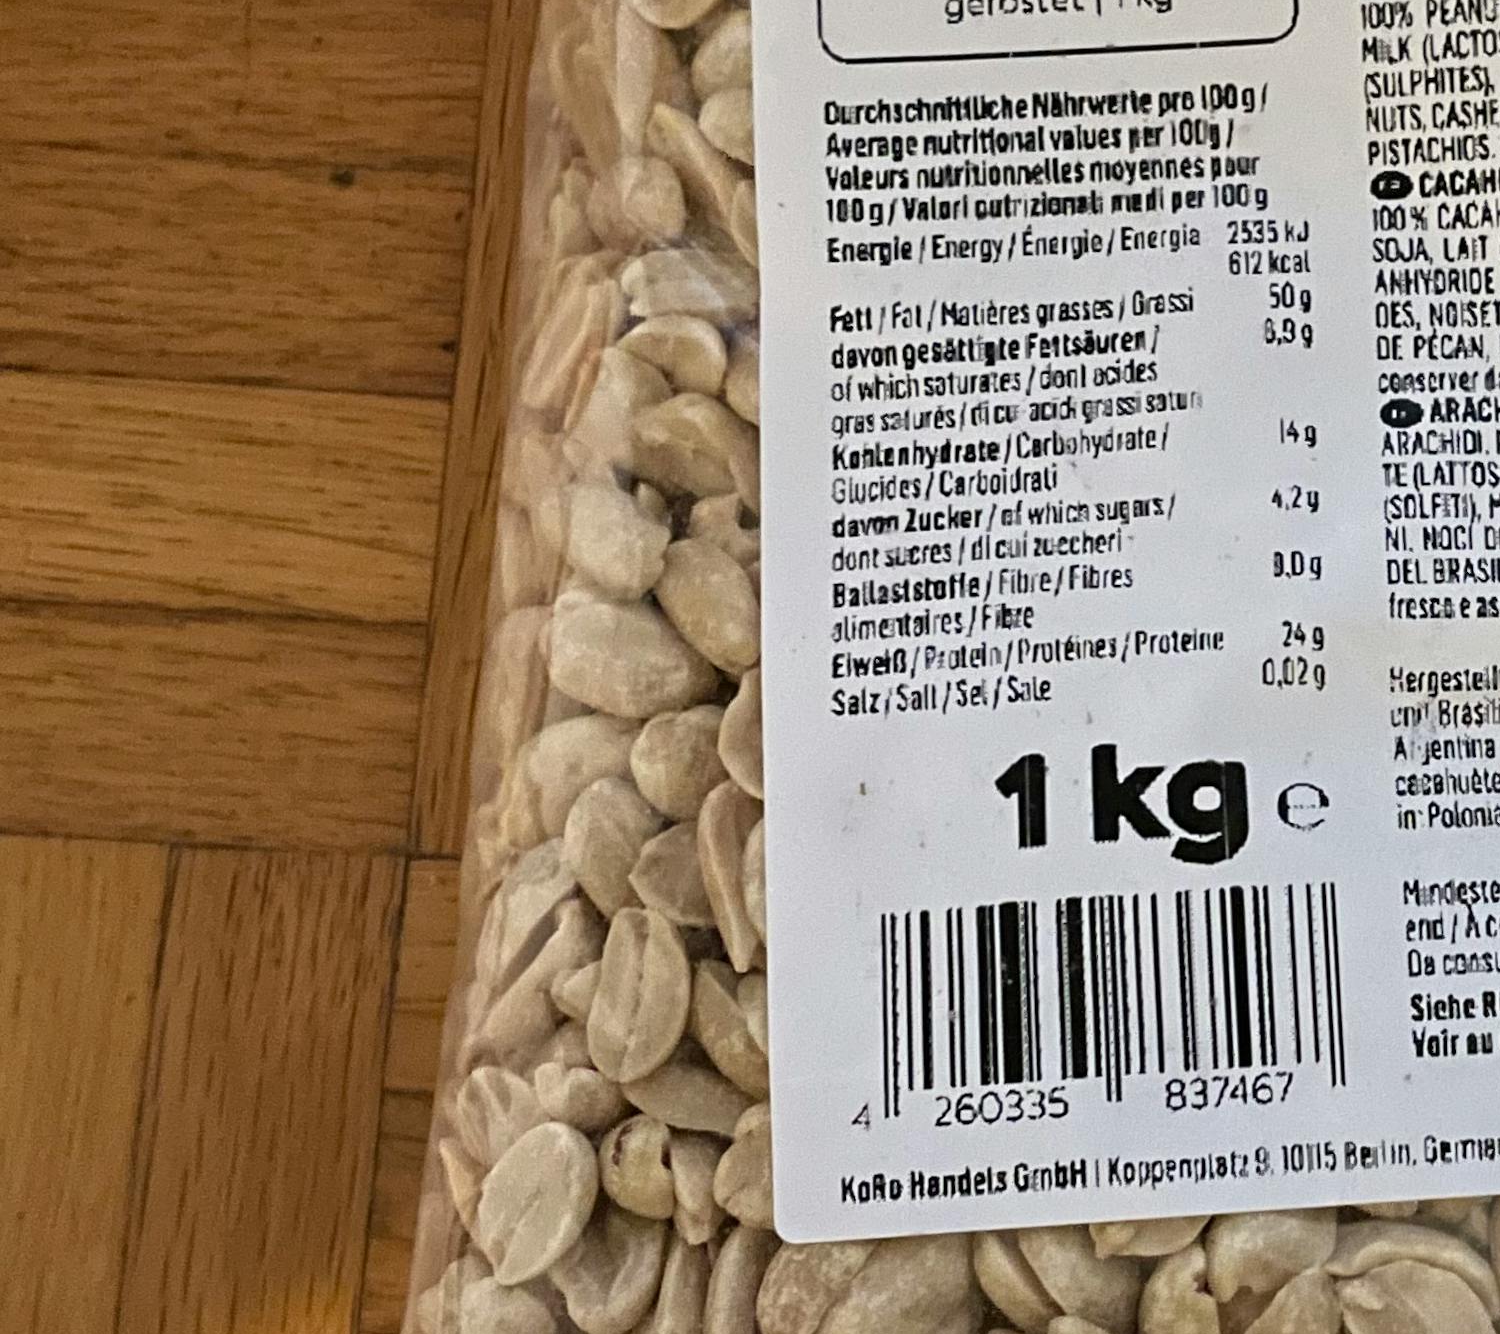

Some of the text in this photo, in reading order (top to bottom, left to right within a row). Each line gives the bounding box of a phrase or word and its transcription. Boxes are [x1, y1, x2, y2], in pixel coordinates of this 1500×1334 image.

[1157, 90, 1196, 118] pro
[1241, 86, 1256, 114] g
[825, 131, 919, 161] Average
[825, 164, 910, 192] Valeurs
[1253, 187, 1269, 212] g
[825, 234, 913, 267] Energie
[931, 233, 1004, 264] Energy
[1120, 222, 1201, 254] Energia
[1228, 248, 1312, 276] 612 kcal
[1035, 298, 1114, 326] grasses
[1268, 280, 1313, 315] 50 g
[830, 341, 899, 370] davon
[830, 374, 854, 403] of
[856, 371, 920, 403] which
[923, 371, 1022, 398] saturates
[1015, 425, 1157, 460] Carbohydrate
[1279, 417, 1318, 449] 14 g
[830, 474, 922, 506] Glucides
[831, 512, 900, 539] davon
[903, 503, 983, 534] Zucker
[831, 546, 881, 573] dont
[1385, 557, 1429, 586] DEL
[1068, 563, 1134, 591] Fibres
[830, 607, 966, 644] alimentaires
[1311, 625, 1325, 652] g
[1017, 634, 1118, 665] Protéines
[1134, 627, 1225, 656] Proteine
[1312, 663, 1327, 691] g
[830, 685, 881, 717] Salz
[1006, 675, 1053, 704] Sale
[993, 742, 1250, 866] 1 kg
[1405, 910, 1446, 943] end
[1411, 1026, 1460, 1059] Voir
[933, 1082, 1070, 1128] 260335
[1164, 1066, 1294, 1113] 837467
[850, 1102, 872, 1132] 4
[840, 1172, 903, 1205] KoRo
[908, 1165, 1008, 1202] Handels
